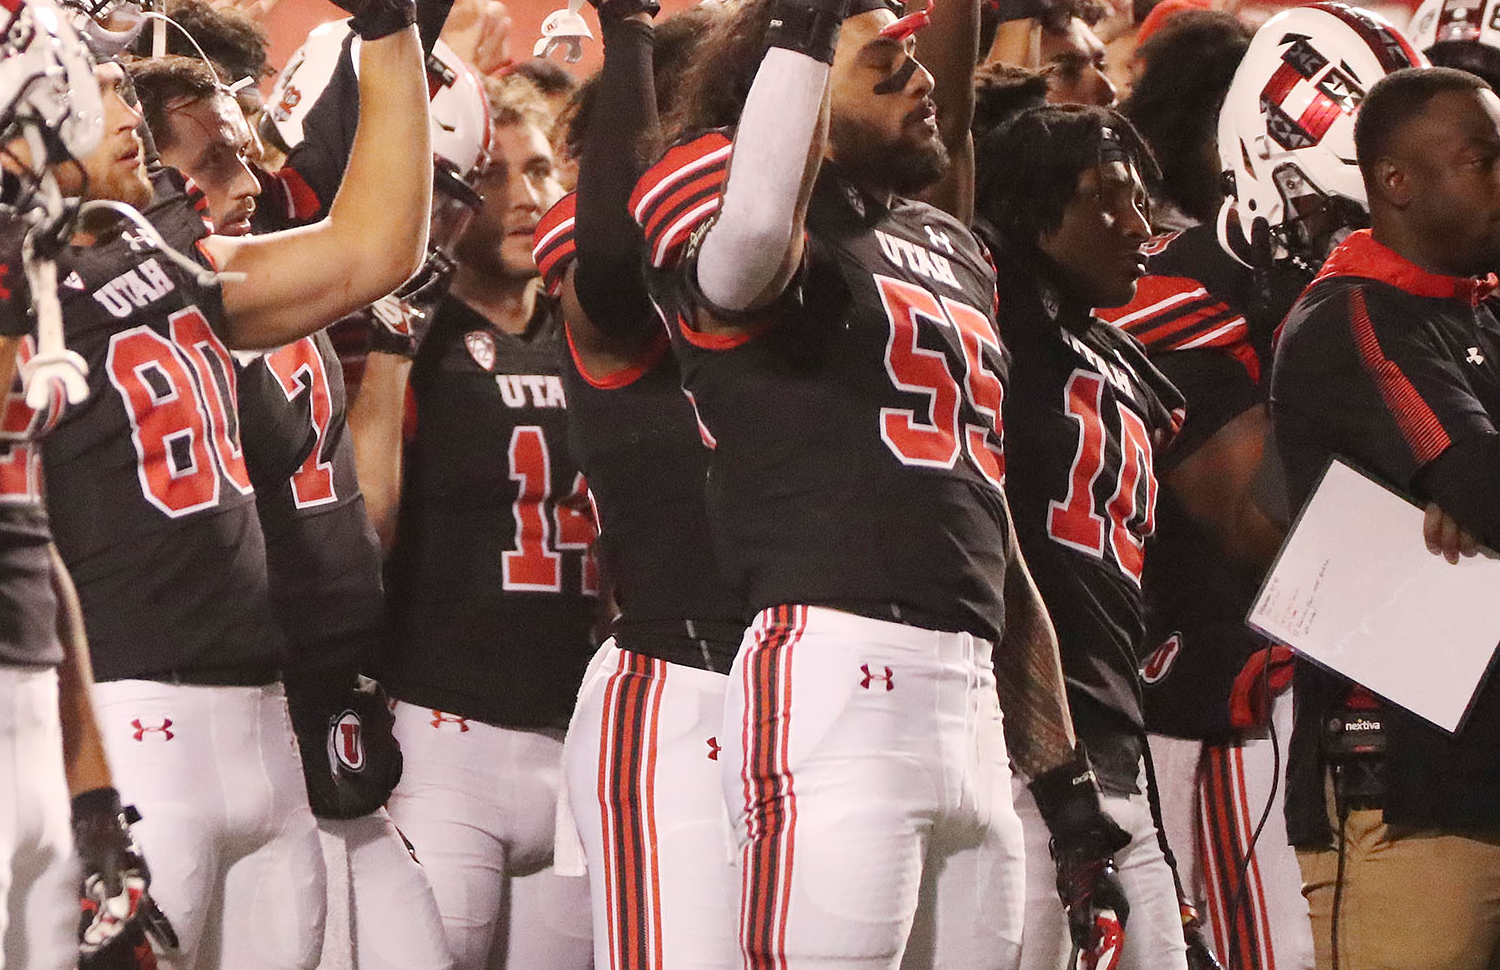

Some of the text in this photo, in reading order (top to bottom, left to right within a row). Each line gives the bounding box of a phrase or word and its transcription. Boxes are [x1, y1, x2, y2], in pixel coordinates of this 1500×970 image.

[92, 257, 175, 318] UTAH
[874, 229, 963, 290] UTAH
[105, 304, 254, 519] 80
[496, 374, 567, 409] UTA
[872, 273, 1006, 492] 55
[1046, 367, 1159, 591] 10
[1345, 718, 1381, 731] nextiva
